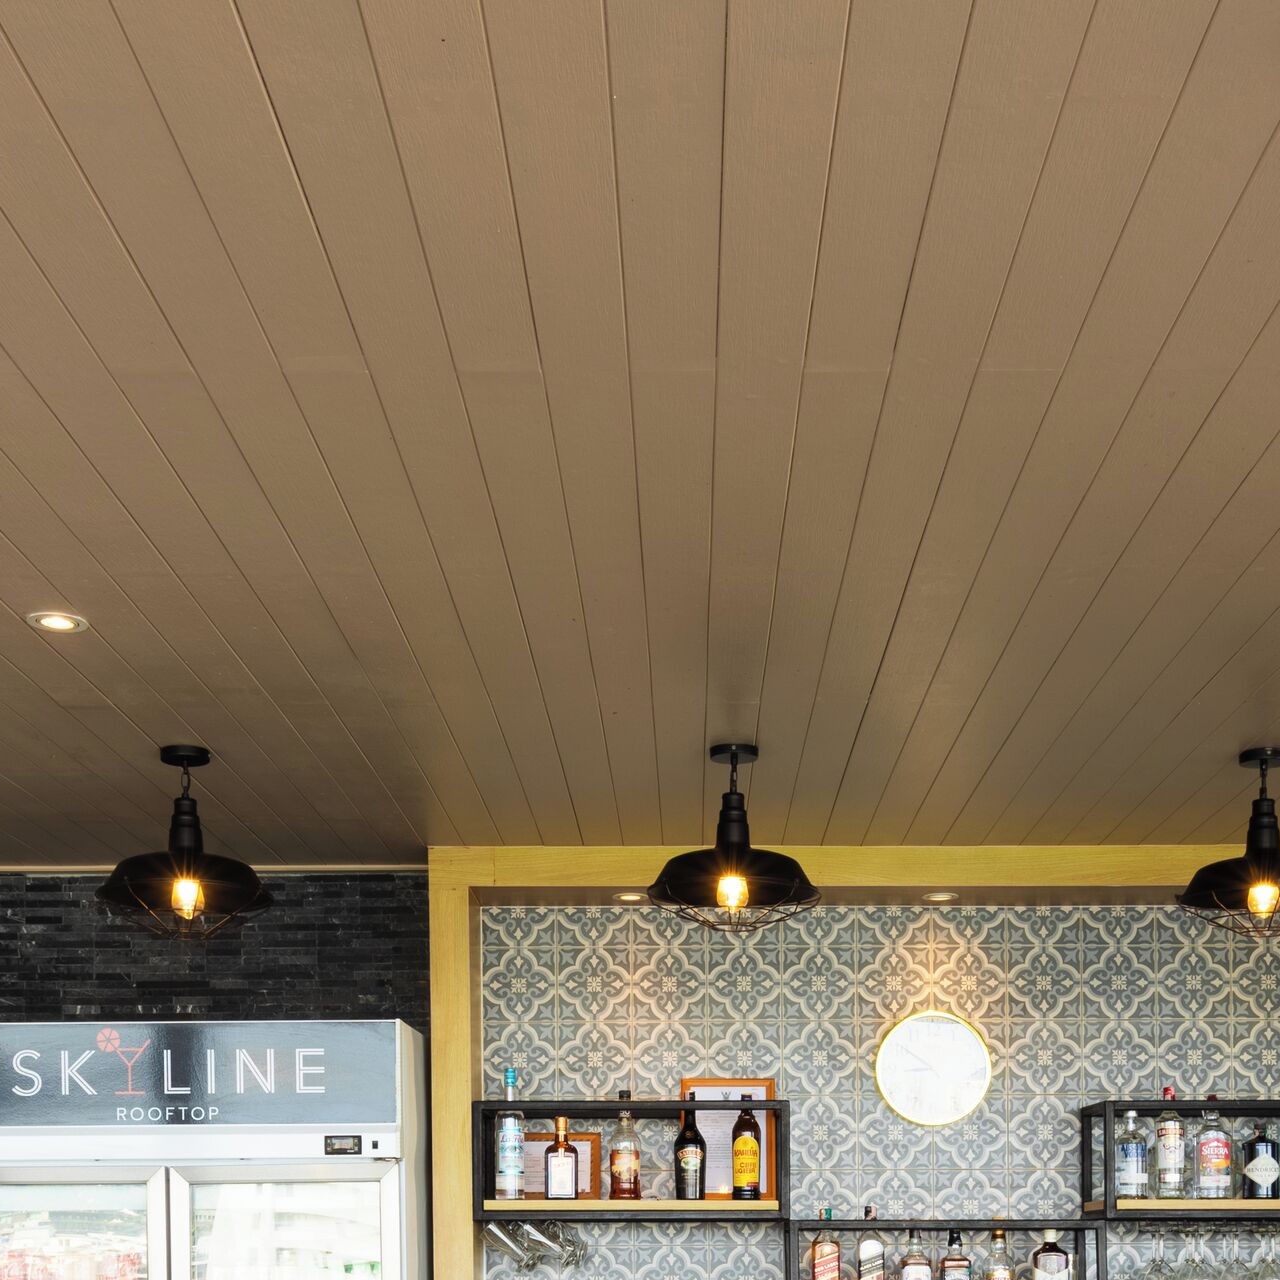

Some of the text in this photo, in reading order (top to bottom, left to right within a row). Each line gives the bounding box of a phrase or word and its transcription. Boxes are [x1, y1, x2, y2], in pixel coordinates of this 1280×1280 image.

[11, 1046, 326, 1097] SKYLINE
[116, 1106, 220, 1122] ROOFTOP
[1201, 1145, 1228, 1155] SIERRA
